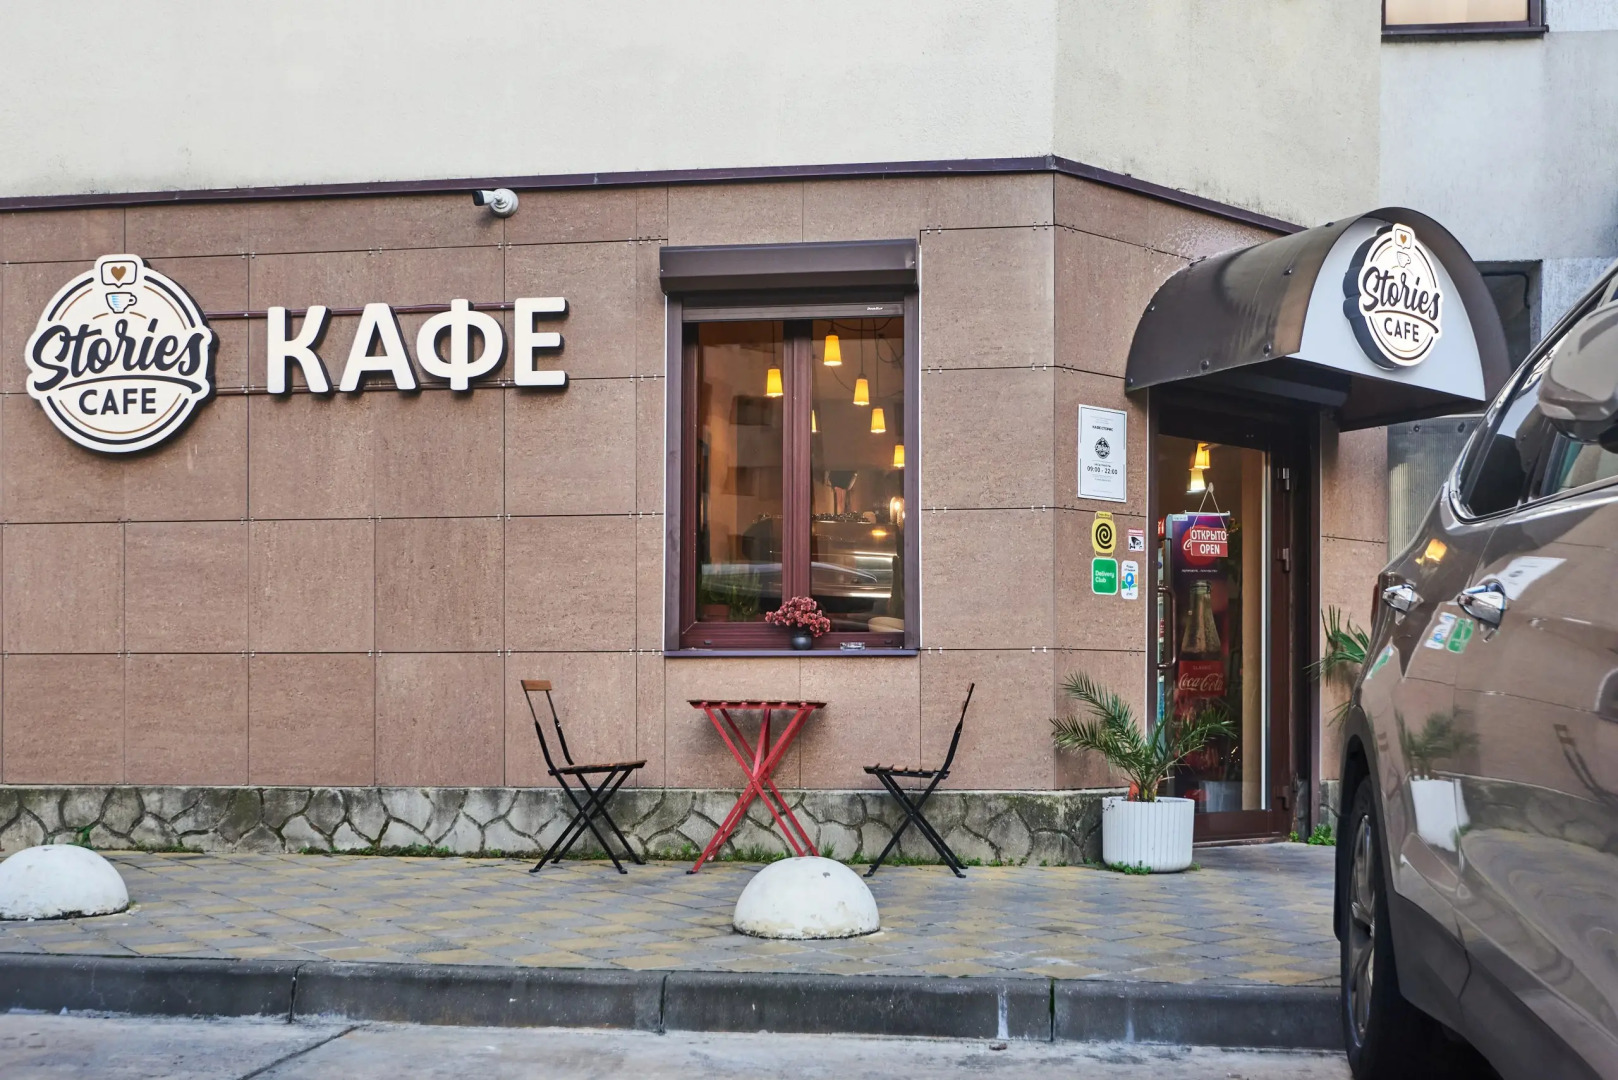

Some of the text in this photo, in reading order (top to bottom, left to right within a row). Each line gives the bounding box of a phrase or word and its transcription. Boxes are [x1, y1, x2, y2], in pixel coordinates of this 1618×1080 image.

[1362, 266, 1441, 321] Stories
[1384, 317, 1420, 343] CAFE
[32, 317, 203, 392] Stories
[266, 296, 567, 394] КАФЕ
[78, 387, 157, 416] CAFE
[1191, 530, 1227, 541] ОТКРЫТО
[1200, 544, 1220, 555] OPEN
[1095, 570, 1115, 579] Delivery
